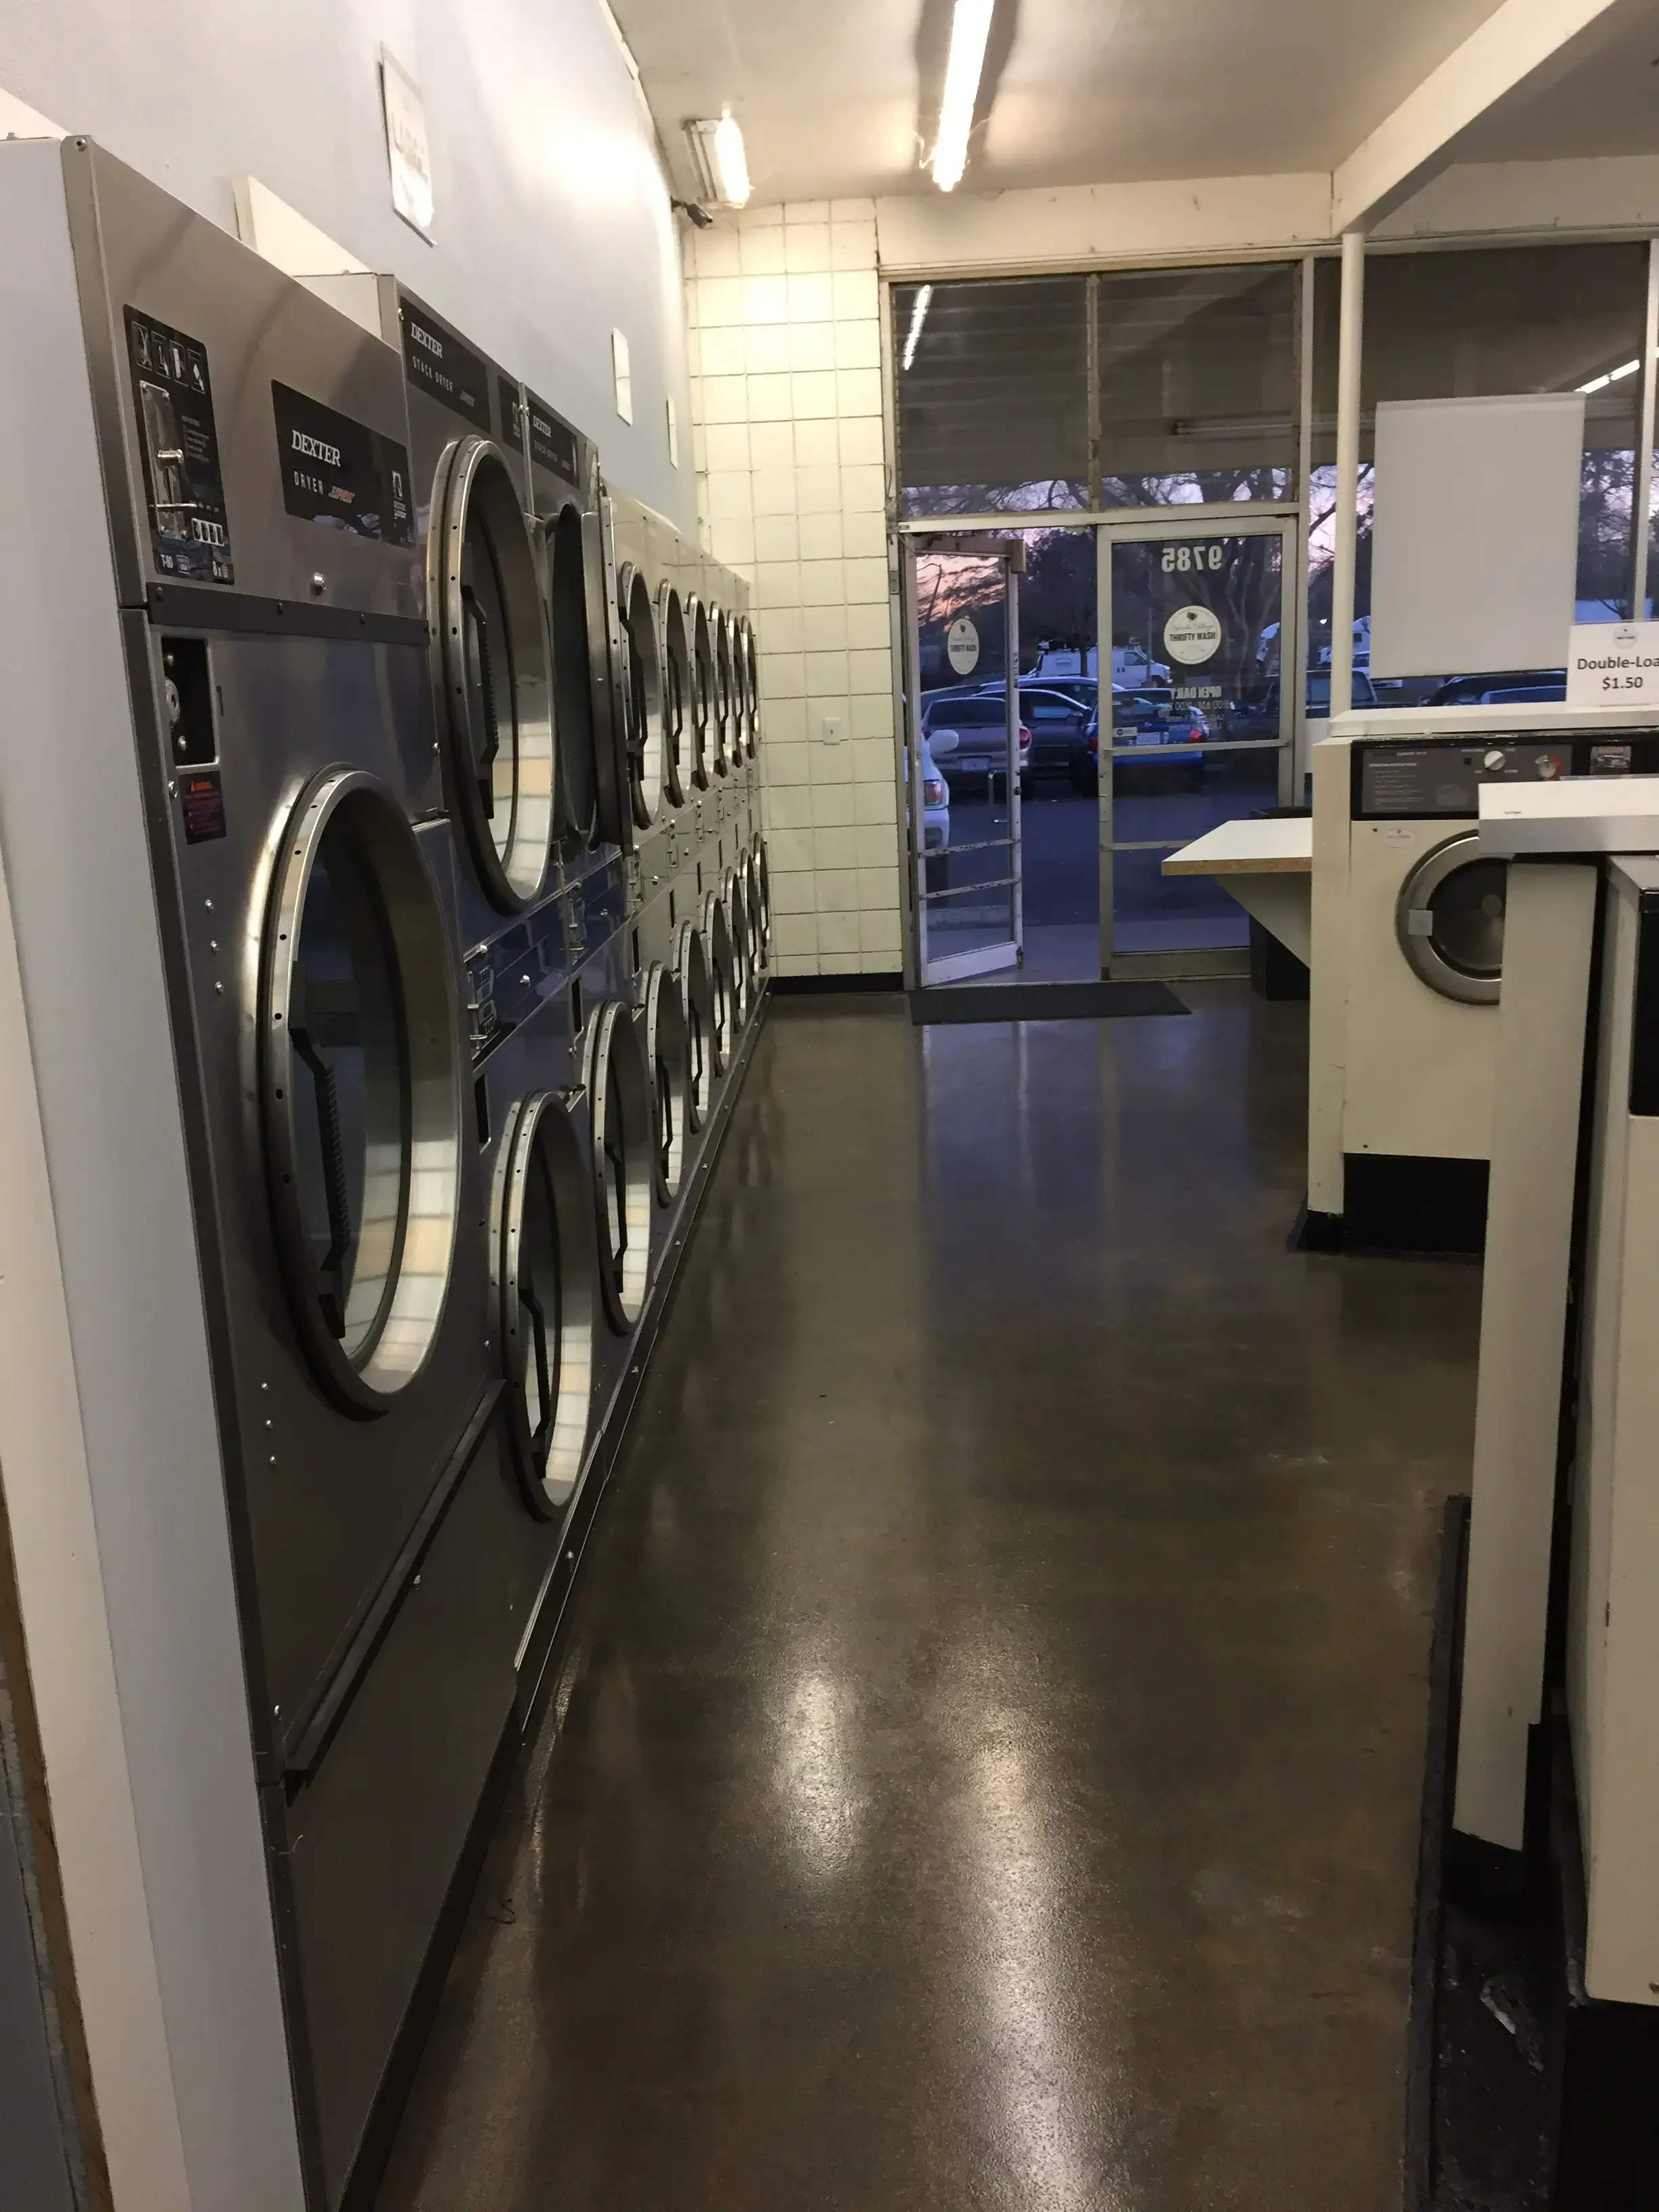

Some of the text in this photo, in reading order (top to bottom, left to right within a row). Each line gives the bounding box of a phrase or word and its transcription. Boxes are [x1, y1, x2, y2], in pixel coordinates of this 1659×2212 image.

[410, 322, 443, 359] DEXTER
[291, 429, 341, 468] DEXTER
[293, 470, 324, 495] DRYER
[1169, 631, 1216, 642] THRIFTY WASH
[1602, 676, 1643, 691] $1.50
